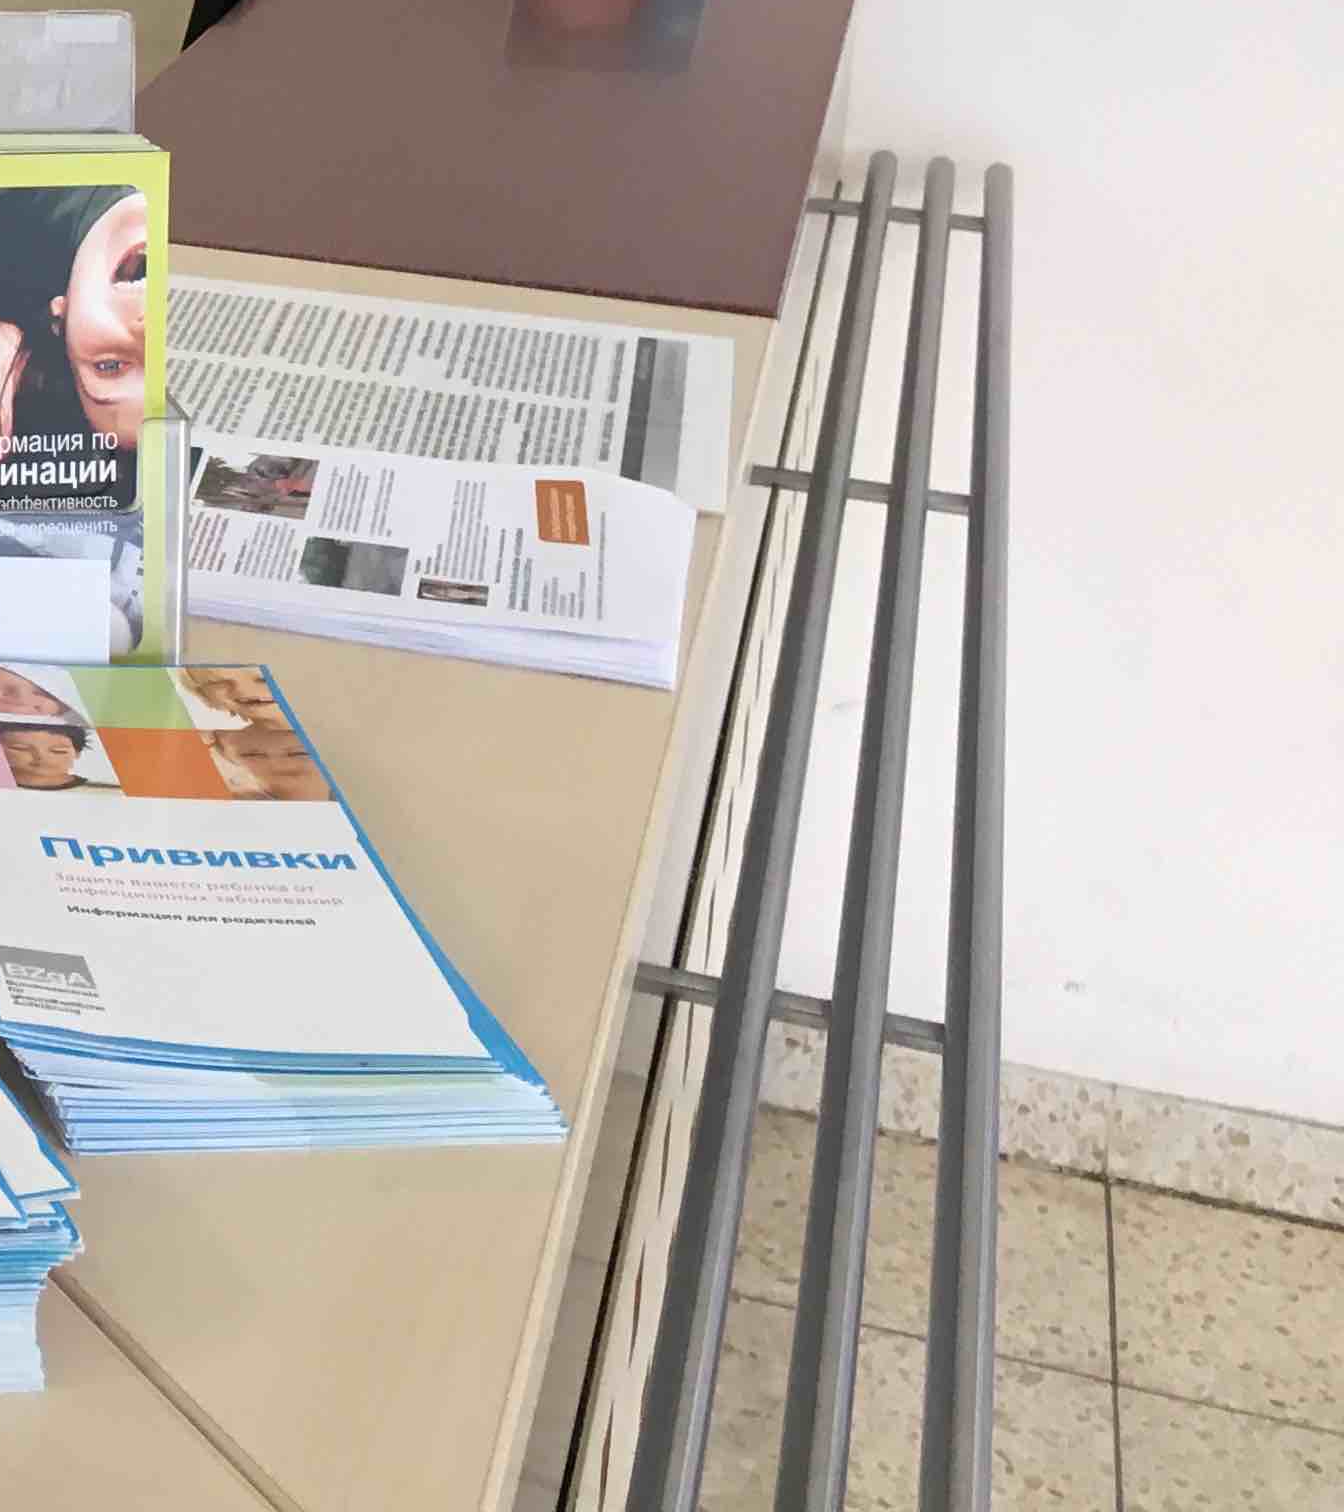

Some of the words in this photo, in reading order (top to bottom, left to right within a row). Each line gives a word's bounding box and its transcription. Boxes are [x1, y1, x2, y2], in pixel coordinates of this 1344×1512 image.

[91, 430, 118, 451] по
[40, 835, 357, 870] Прививки
[66, 904, 183, 922] Информация
[187, 914, 218, 924] для
[220, 915, 317, 926] родителей
